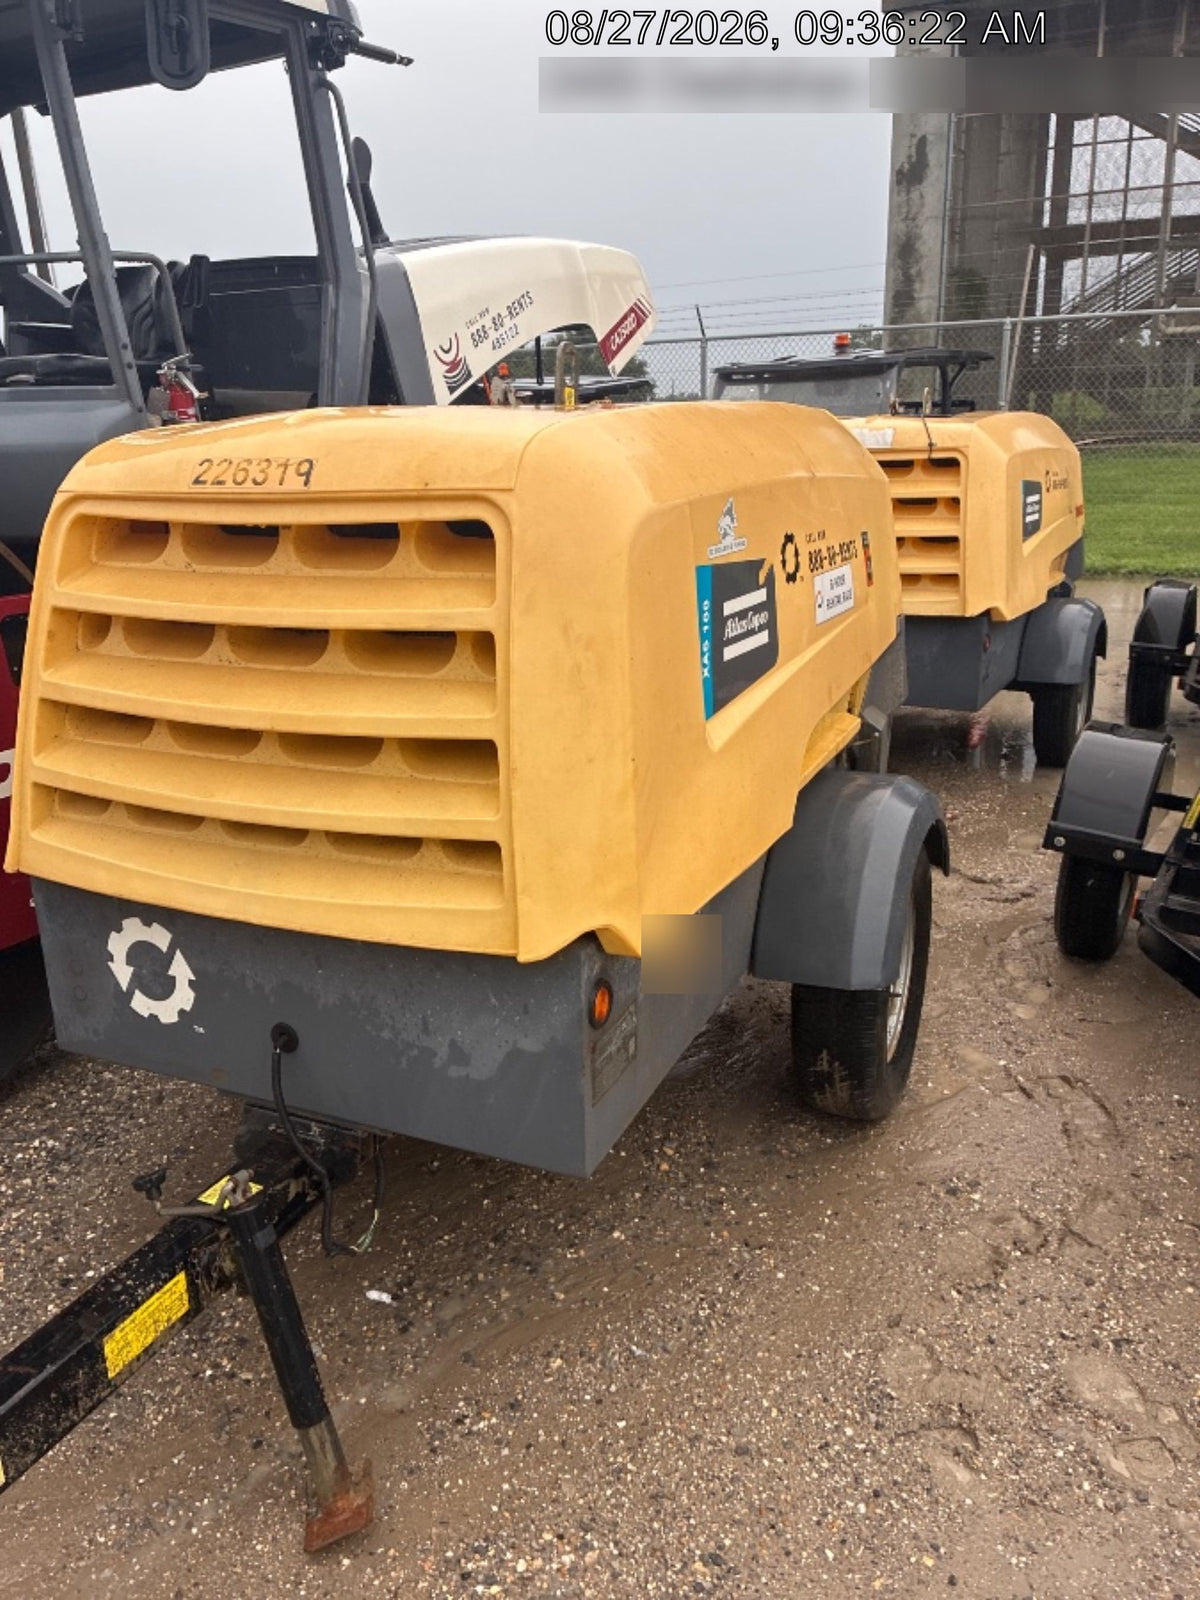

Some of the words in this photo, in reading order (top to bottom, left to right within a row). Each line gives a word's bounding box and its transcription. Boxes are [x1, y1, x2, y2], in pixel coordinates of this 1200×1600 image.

[470, 290, 534, 348] 888-80-RENTS
[191, 458, 315, 487] 226319
[723, 616, 747, 641] Atlas
[747, 611, 769, 631] Copco
[702, 640, 710, 678] XAS
